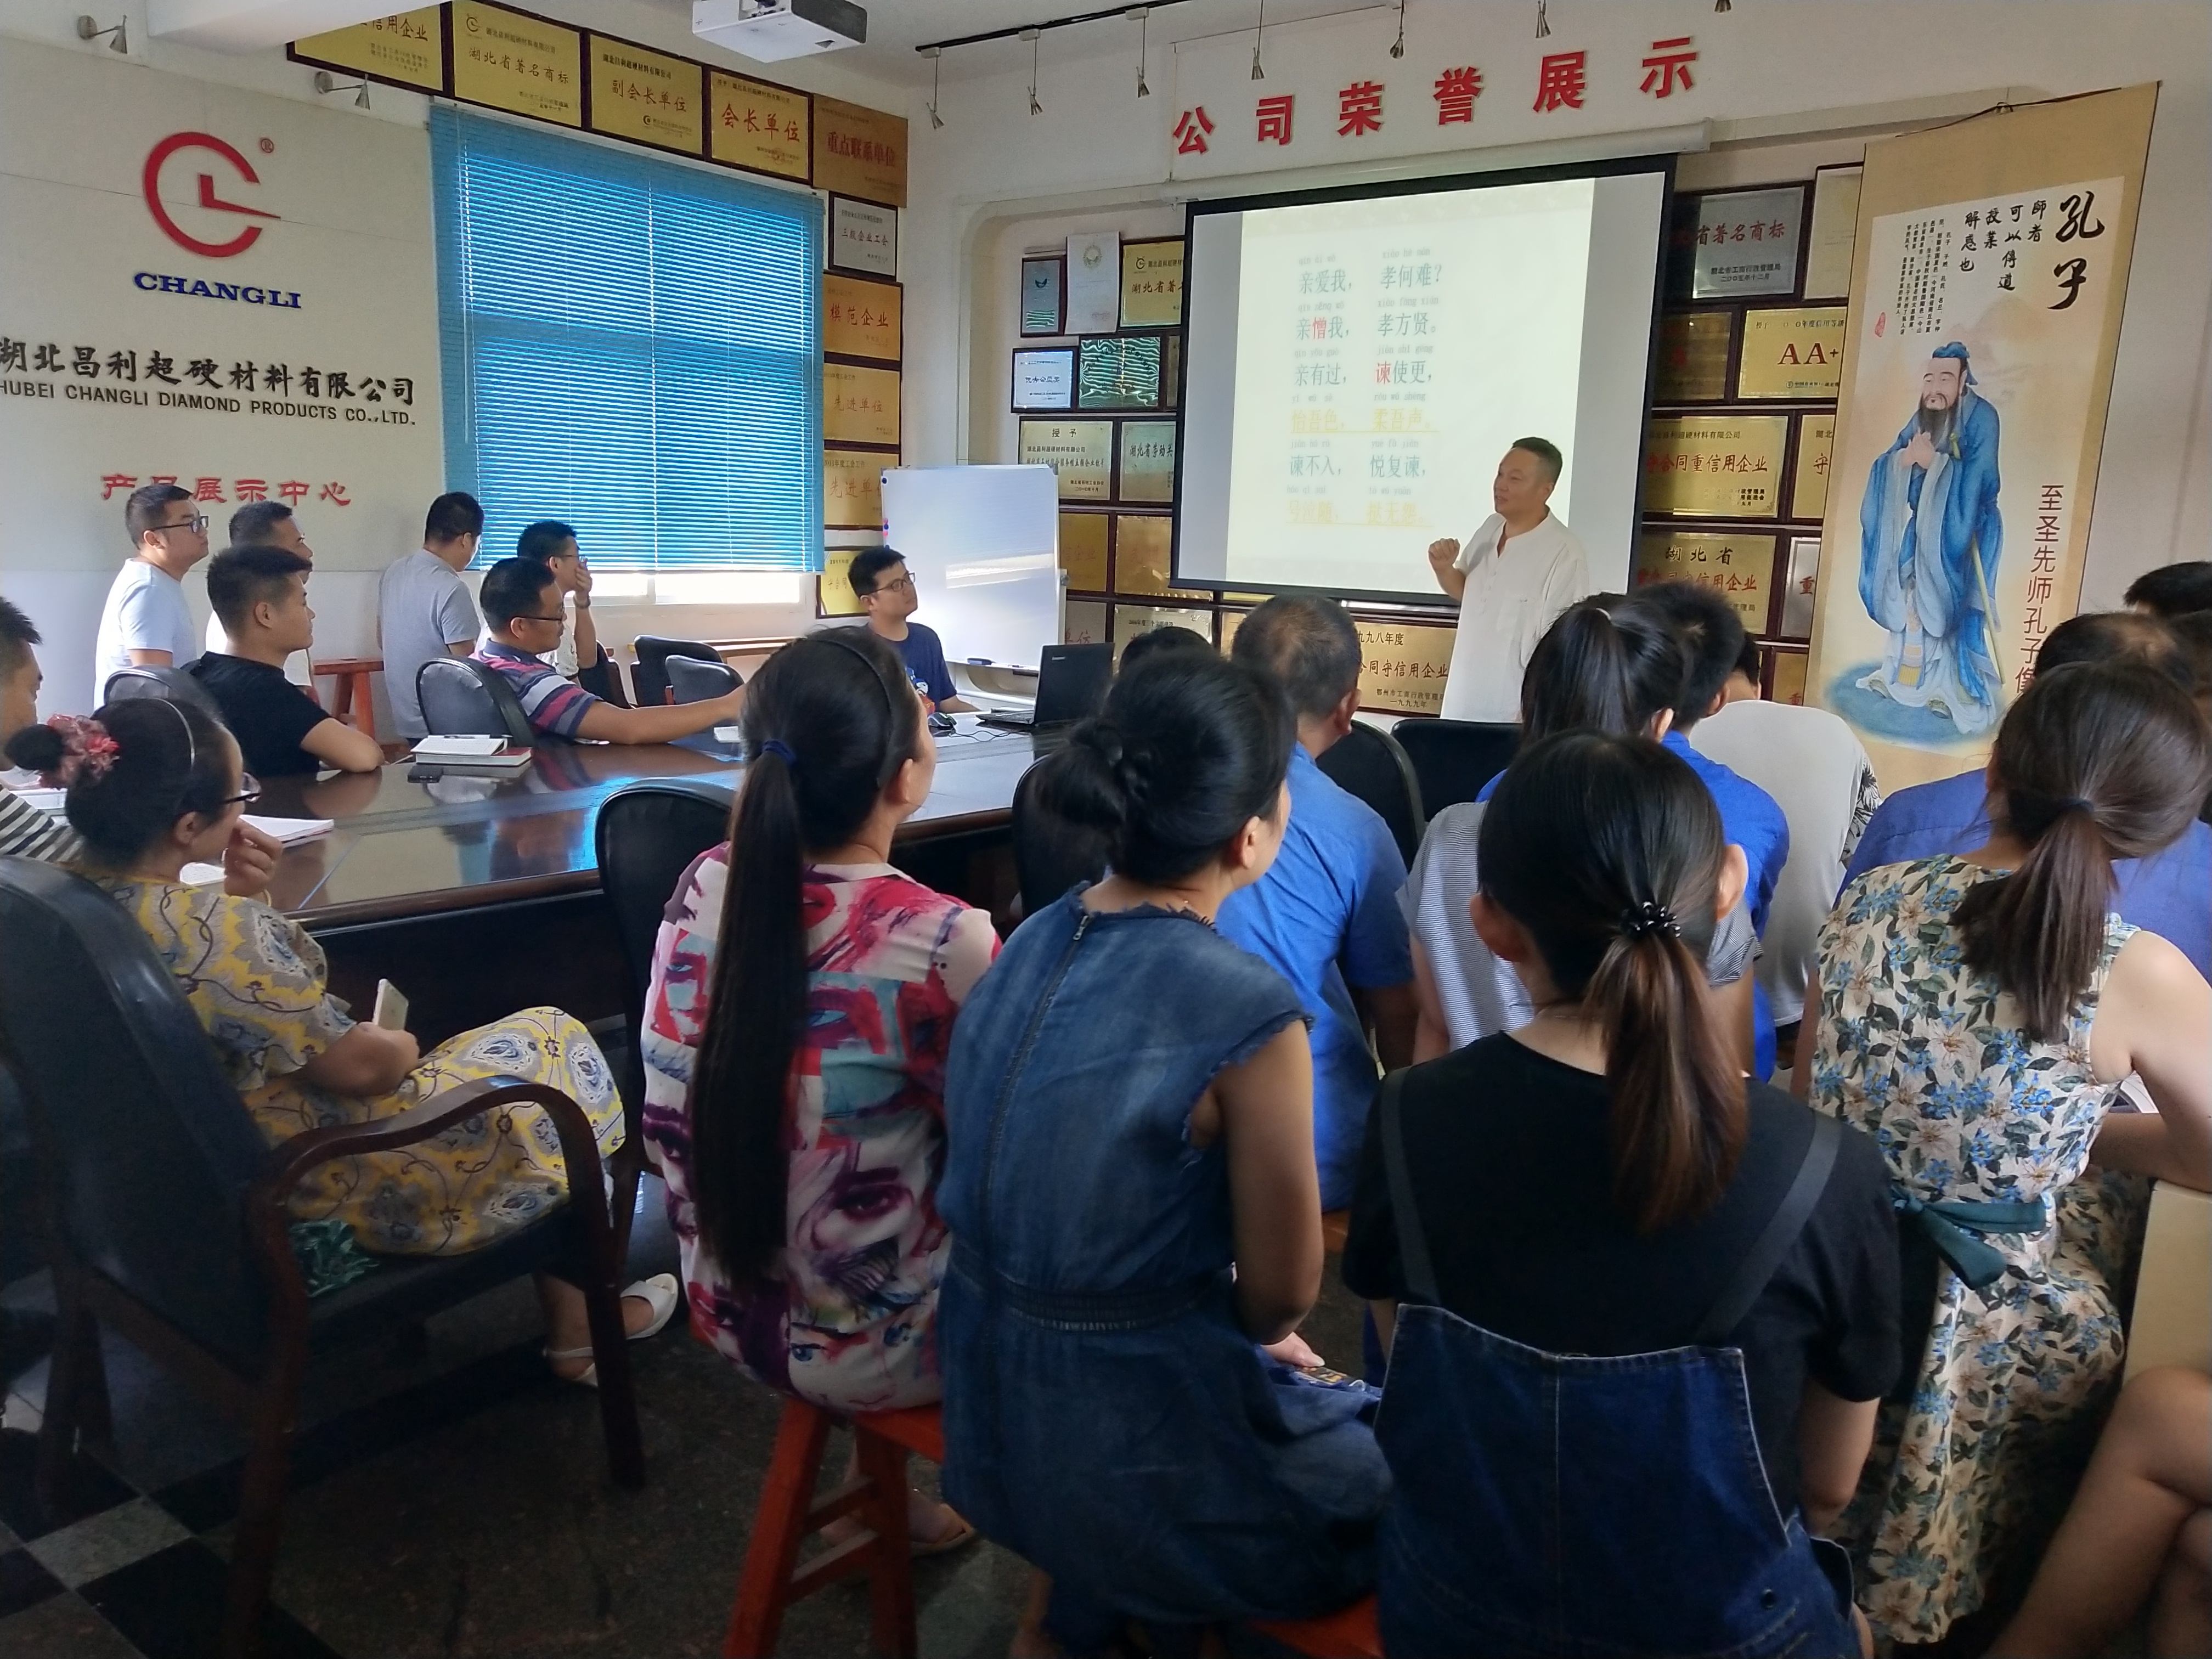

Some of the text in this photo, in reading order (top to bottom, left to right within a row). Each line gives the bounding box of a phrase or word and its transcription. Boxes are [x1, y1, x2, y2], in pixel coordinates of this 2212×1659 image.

[360, 15, 428, 41] 信用企业
[469, 47, 568, 84] 湖北省著名商标
[612, 80, 686, 112] 副会长单位
[1173, 36, 1699, 154] 公司荣誉展示
[721, 103, 800, 143] 会长单位
[2047, 190, 2105, 310] 孔子
[134, 272, 302, 309] CHANGLI
[1132, 279, 1183, 294] 湖北省著
[830, 302, 889, 327] 模范企业
[1778, 342, 1839, 365] AA+
[0, 336, 414, 406] 湖北昌利超硬材料有限公司
[65, 385, 148, 406] CHANGLI
[159, 392, 240, 413] DIAMOND
[251, 400, 336, 420] PRODUCTS
[834, 394, 883, 413] 先进单位
[1052, 428, 1077, 438] 授予
[1813, 452, 1829, 475] 守
[830, 476, 881, 500] 先进单
[1666, 545, 1733, 565] 湖北省
[1799, 576, 1815, 595] 重
[2015, 484, 2064, 693] 至圣先师孔子像
[1390, 699, 1427, 709] 一九九九年
